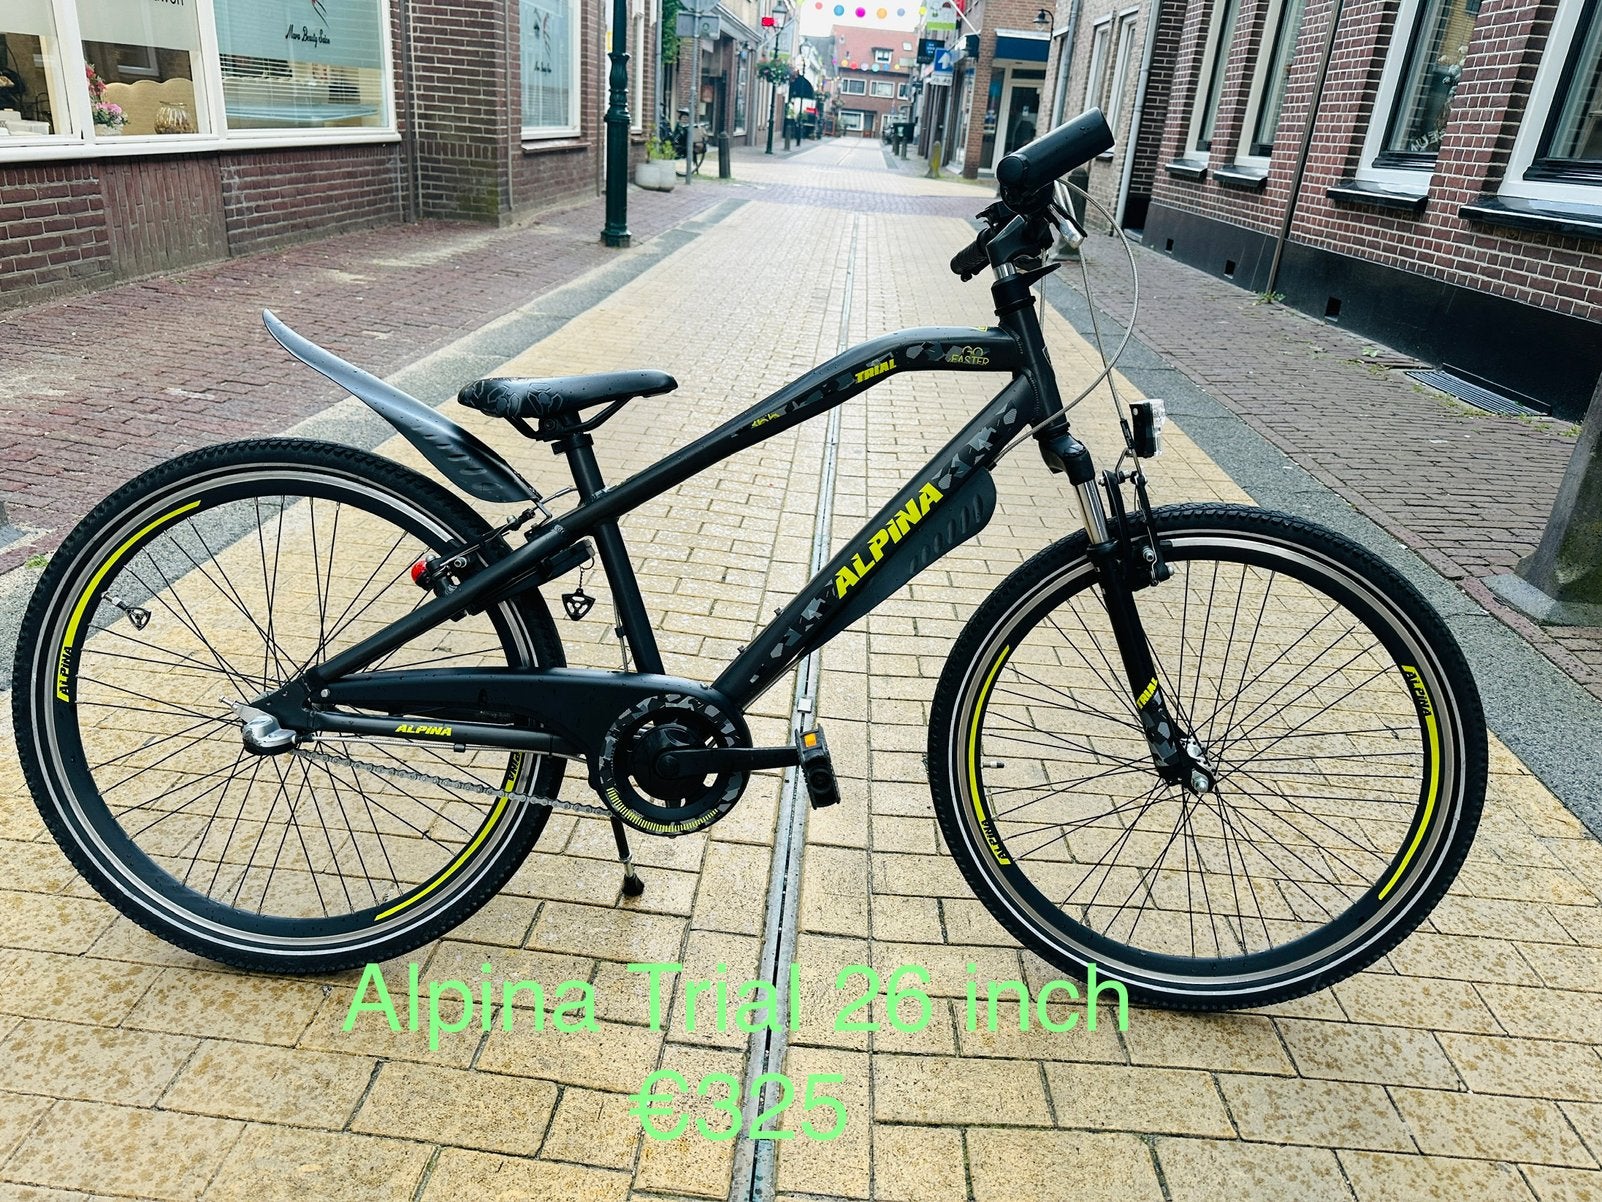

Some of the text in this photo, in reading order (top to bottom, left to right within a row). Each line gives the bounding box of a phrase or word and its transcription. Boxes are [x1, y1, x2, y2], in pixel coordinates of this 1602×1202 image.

[950, 353, 990, 366] FASTER
[961, 345, 984, 357] GO
[854, 358, 897, 383] TRIAL
[834, 482, 944, 600] ALPINA
[58, 646, 73, 696] ALPINA
[1136, 677, 1159, 710] TRIAL
[1403, 670, 1432, 717] ALPINA
[395, 723, 453, 737] ALPINA
[981, 819, 1009, 860] ALPINA
